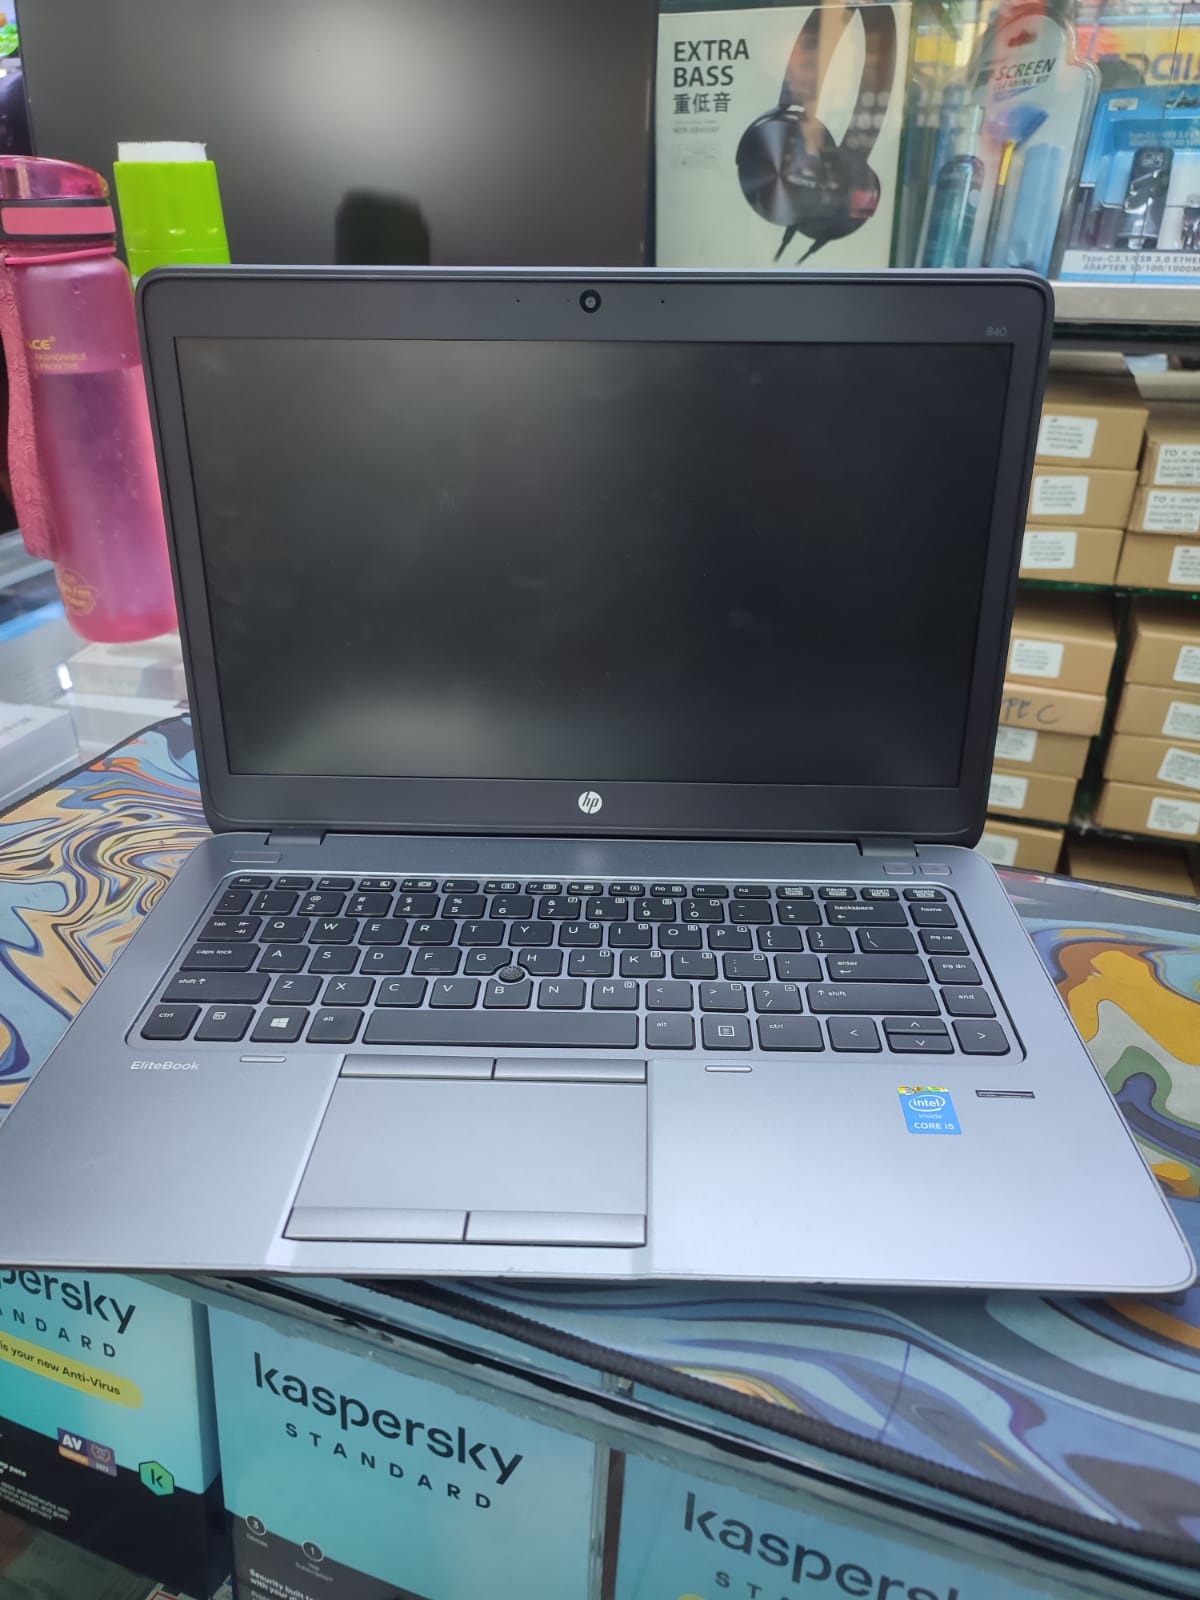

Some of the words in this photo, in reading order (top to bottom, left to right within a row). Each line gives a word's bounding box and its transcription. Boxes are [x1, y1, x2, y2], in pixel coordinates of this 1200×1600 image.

[674, 39, 749, 62] EXTRA
[995, 57, 1056, 81] SCREEN
[673, 65, 734, 88] BASS
[673, 92, 731, 114] 重低音
[578, 791, 603, 814] hp
[273, 921, 285, 929] Q
[323, 923, 339, 931] W
[272, 950, 282, 958] A
[322, 951, 331, 959] S
[373, 952, 384, 960] D
[476, 953, 487, 961] G
[527, 954, 537, 962] H
[630, 955, 639, 963] K
[282, 981, 295, 989] Z
[336, 982, 347, 990] X
[443, 984, 453, 992] V
[495, 986, 504, 994] B
[603, 986, 614, 994] M
[130, 1061, 200, 1070] EliteBook
[913, 1122, 942, 1130] CORE
[11, 1346, 35, 1363] your
[36, 1358, 60, 1372] new
[62, 1366, 121, 1396] Anti-Virus
[253, 1352, 524, 1485] kaspersky
[62, 1433, 82, 1451] AV
[285, 1422, 492, 1510] STANDARD
[250, 1568, 284, 1590] Security
